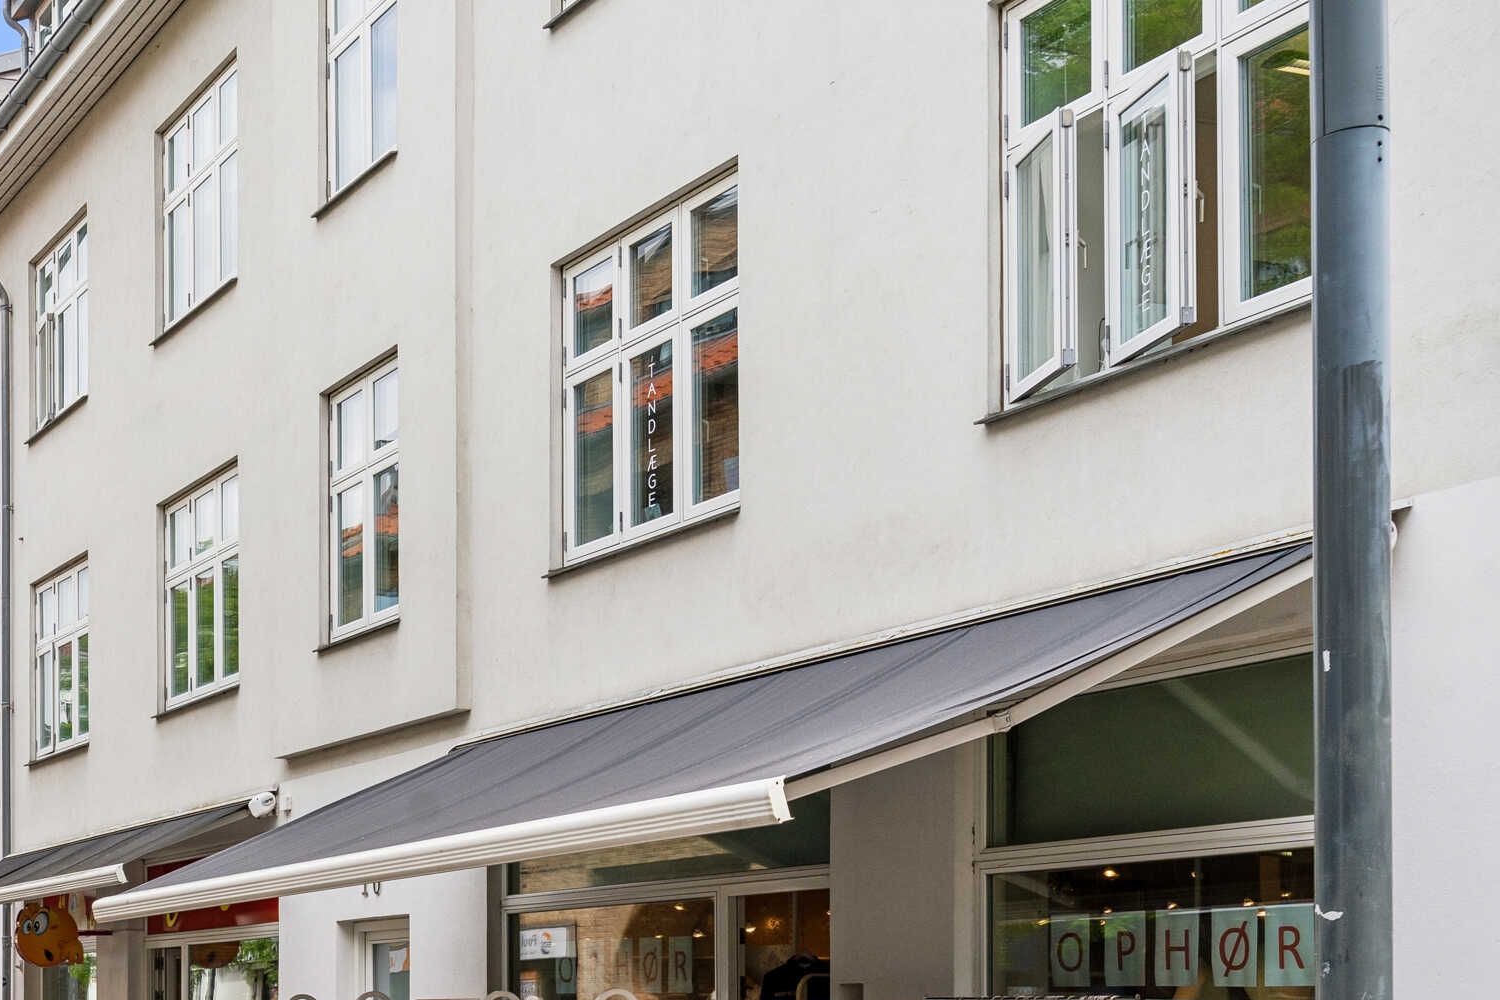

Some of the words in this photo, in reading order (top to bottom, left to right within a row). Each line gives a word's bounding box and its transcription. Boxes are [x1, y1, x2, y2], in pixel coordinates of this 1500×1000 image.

[1140, 112, 1152, 312] TANDLÆGE
[647, 362, 657, 508] TANDLÆGE
[1057, 920, 1305, 977] OPHØR
